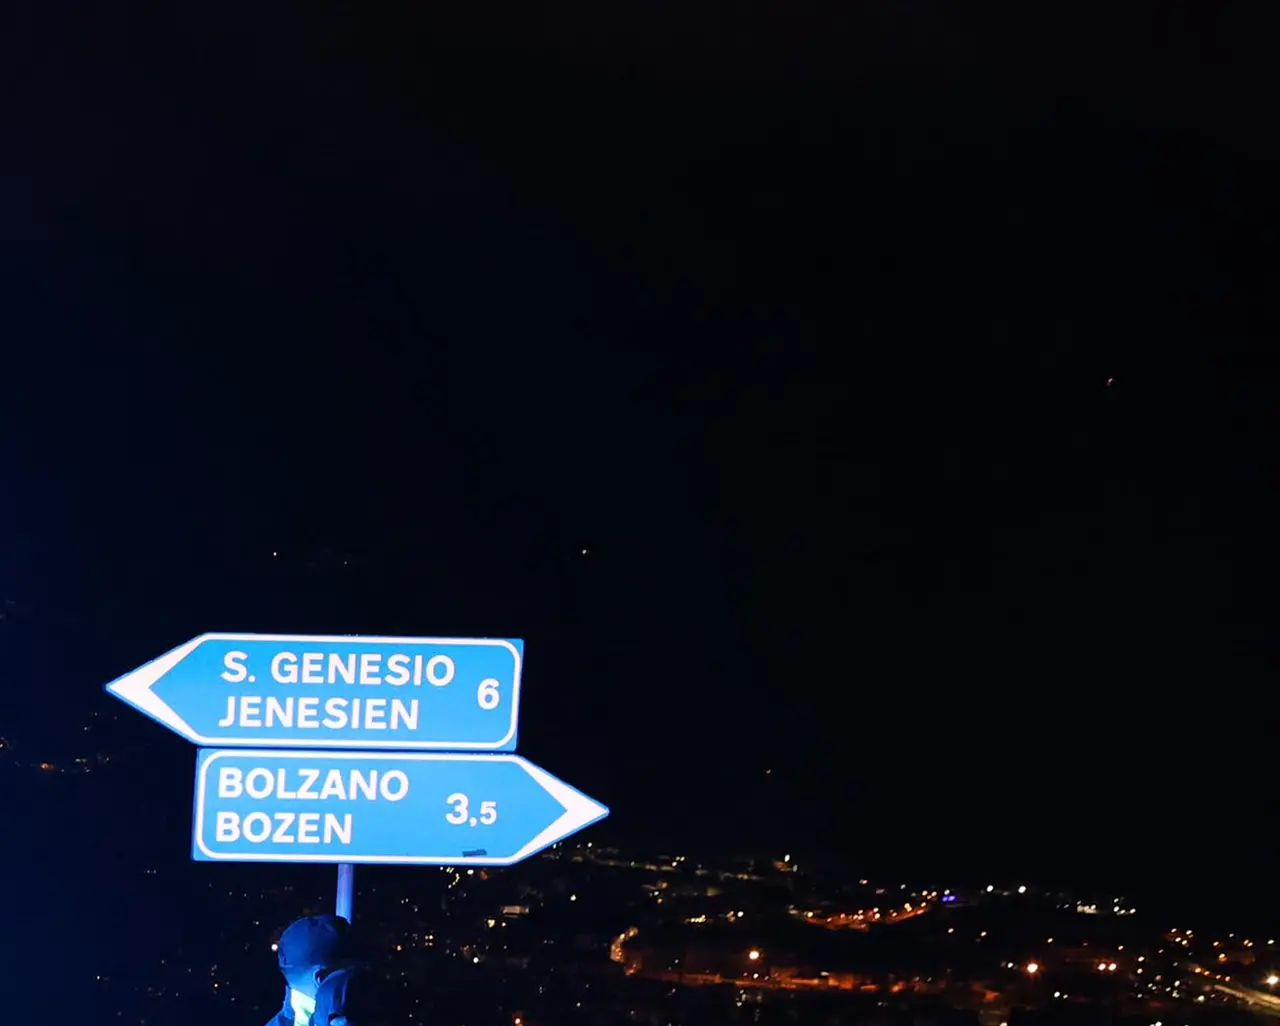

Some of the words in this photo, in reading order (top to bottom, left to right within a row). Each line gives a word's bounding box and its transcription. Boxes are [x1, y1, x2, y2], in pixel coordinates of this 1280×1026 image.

[220, 650, 256, 683] S.
[270, 650, 455, 688] GENESIO
[477, 678, 500, 710] 6
[218, 695, 419, 731] JENESIEN
[217, 766, 410, 802] BOLZANO
[215, 810, 353, 845] BOZEN
[445, 792, 498, 828] 3,5
